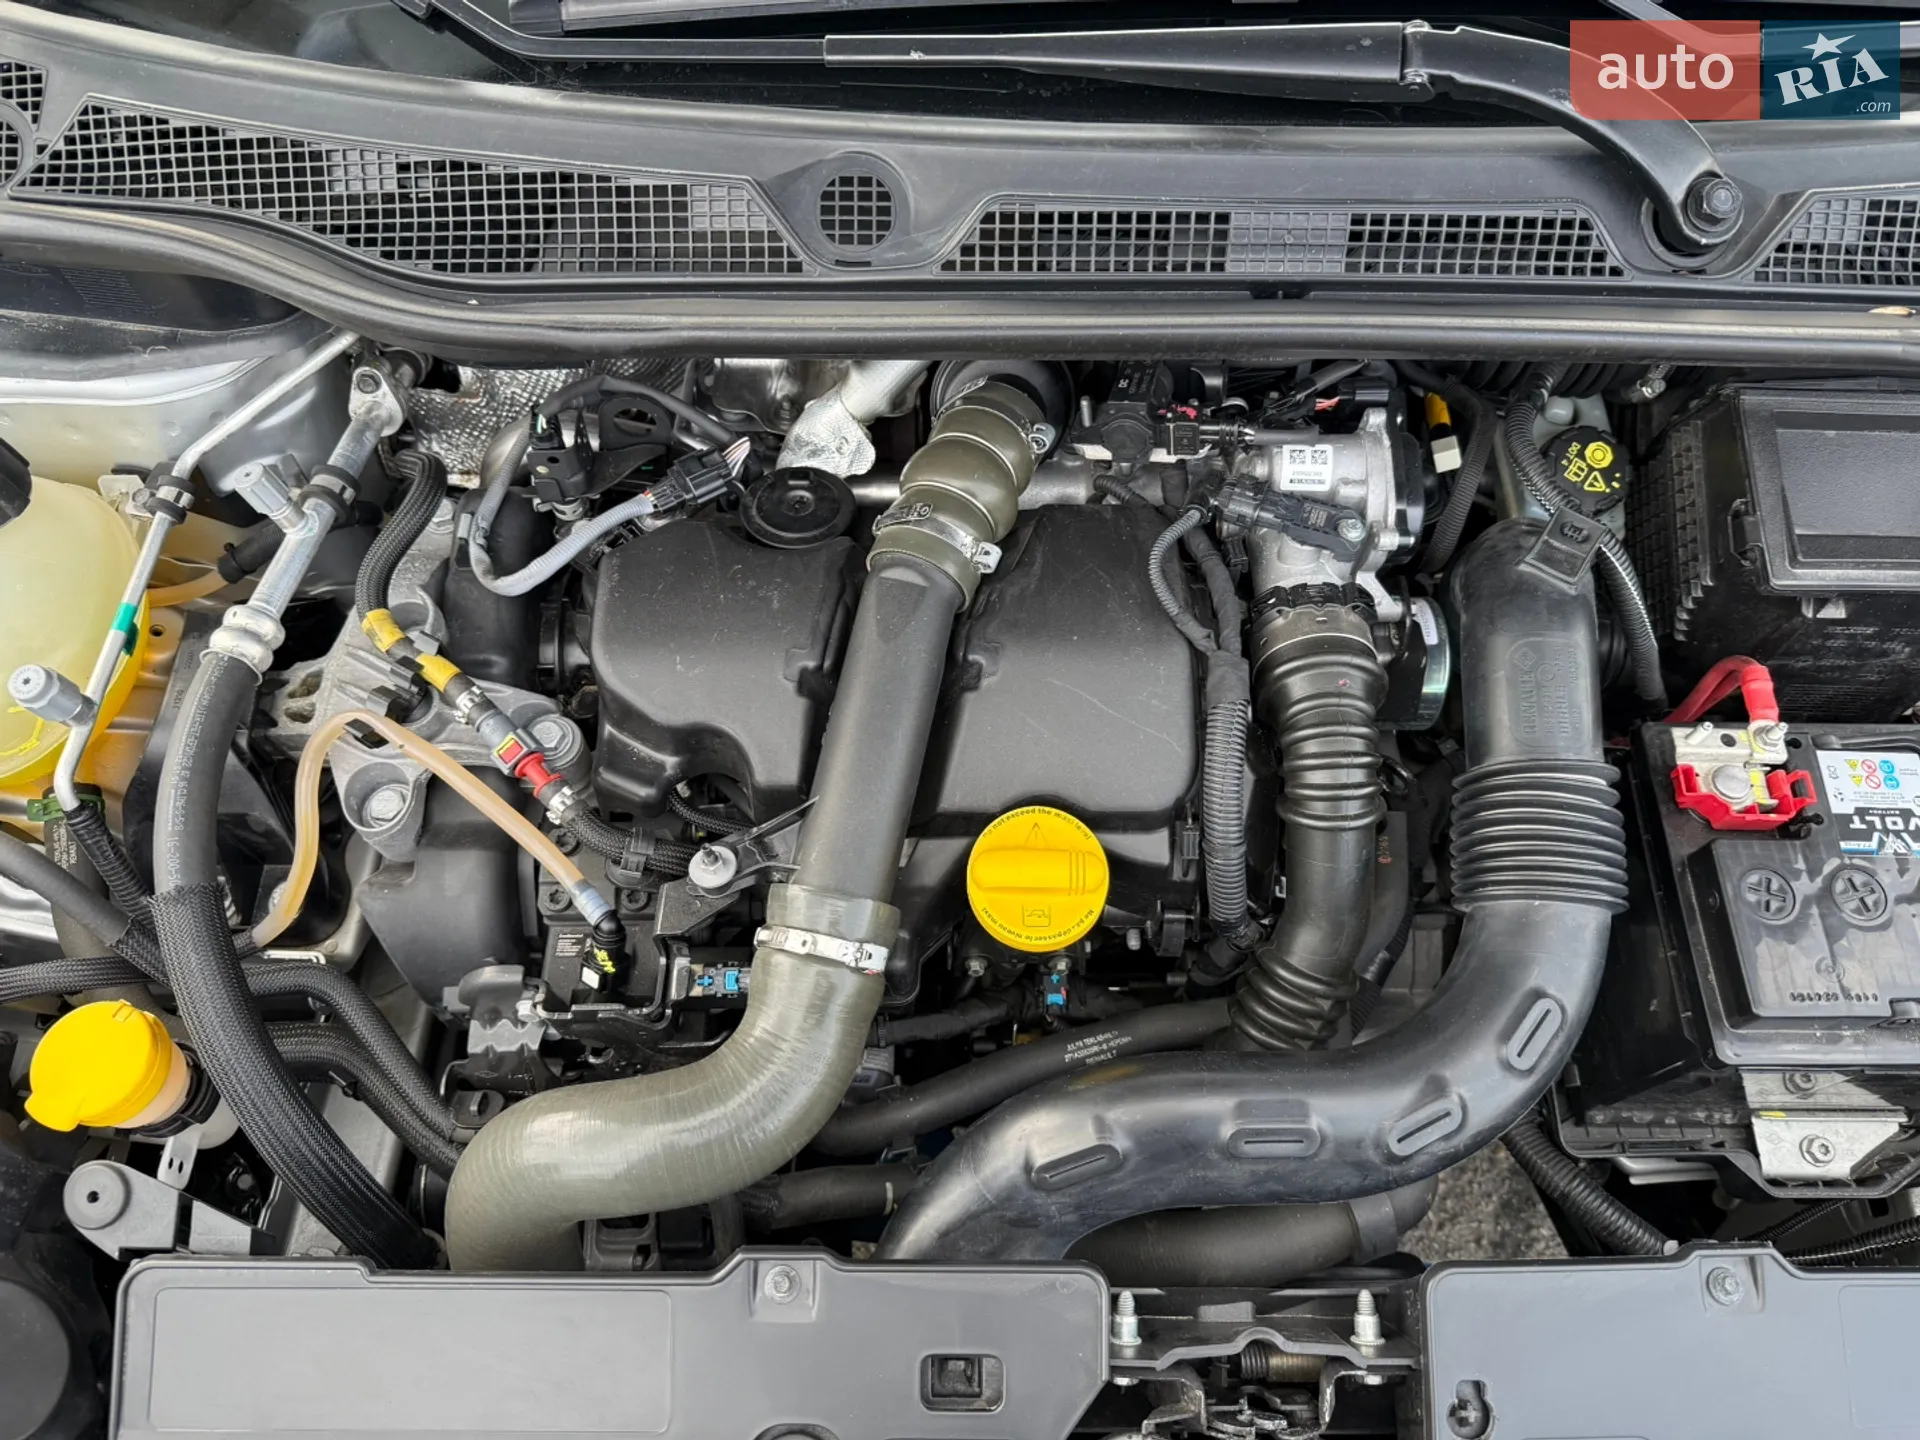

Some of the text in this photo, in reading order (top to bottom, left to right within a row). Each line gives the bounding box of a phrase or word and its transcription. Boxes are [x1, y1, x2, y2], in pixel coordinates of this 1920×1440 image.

[1566, 441, 1581, 460] DOT
[1006, 808, 1036, 821] exceed
[1038, 808, 1052, 816] the
[1849, 815, 1920, 831] VOLT
